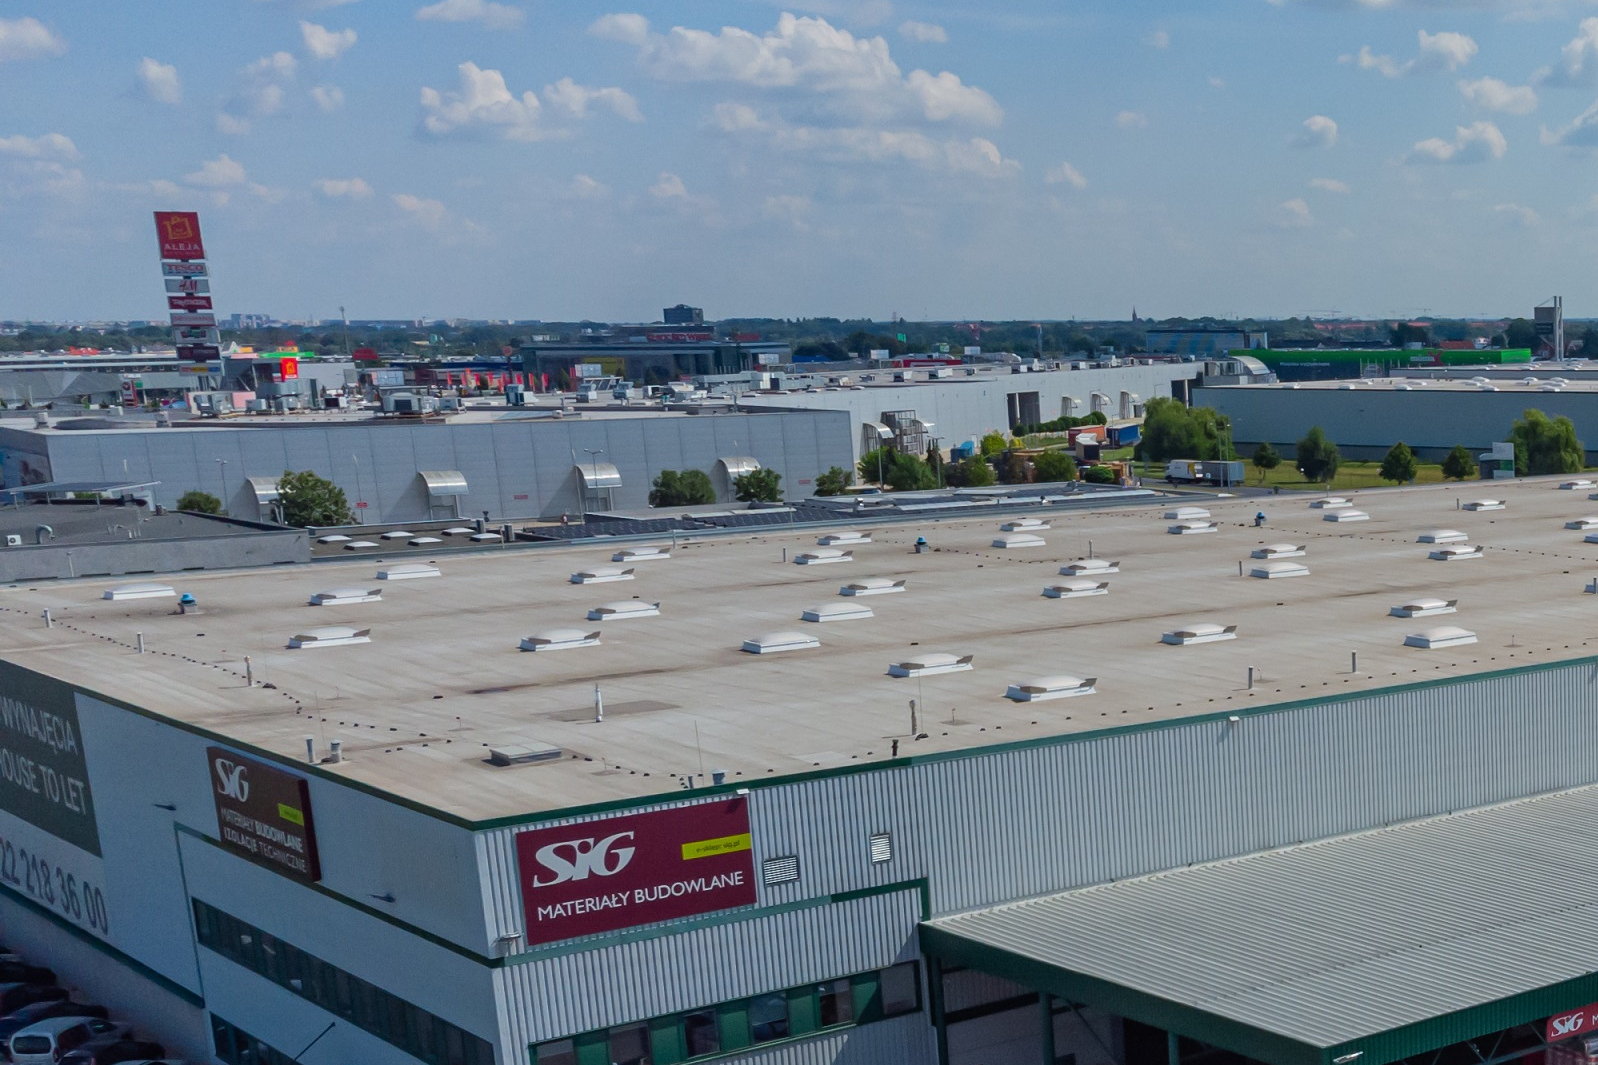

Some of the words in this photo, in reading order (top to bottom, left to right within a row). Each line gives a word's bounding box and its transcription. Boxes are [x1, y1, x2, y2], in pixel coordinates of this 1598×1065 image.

[39, 764, 60, 802] TO
[60, 774, 86, 815] LET
[215, 758, 249, 802] SIG
[254, 820, 304, 853] BUDOWLANE
[532, 830, 636, 888] SIG
[20, 848, 55, 905] 218
[56, 866, 81, 919] 36
[83, 881, 108, 935] 00
[537, 891, 630, 921] MATERIAŁY
[633, 870, 745, 904] BUDOWLANE
[1551, 1012, 1584, 1037] SIG
